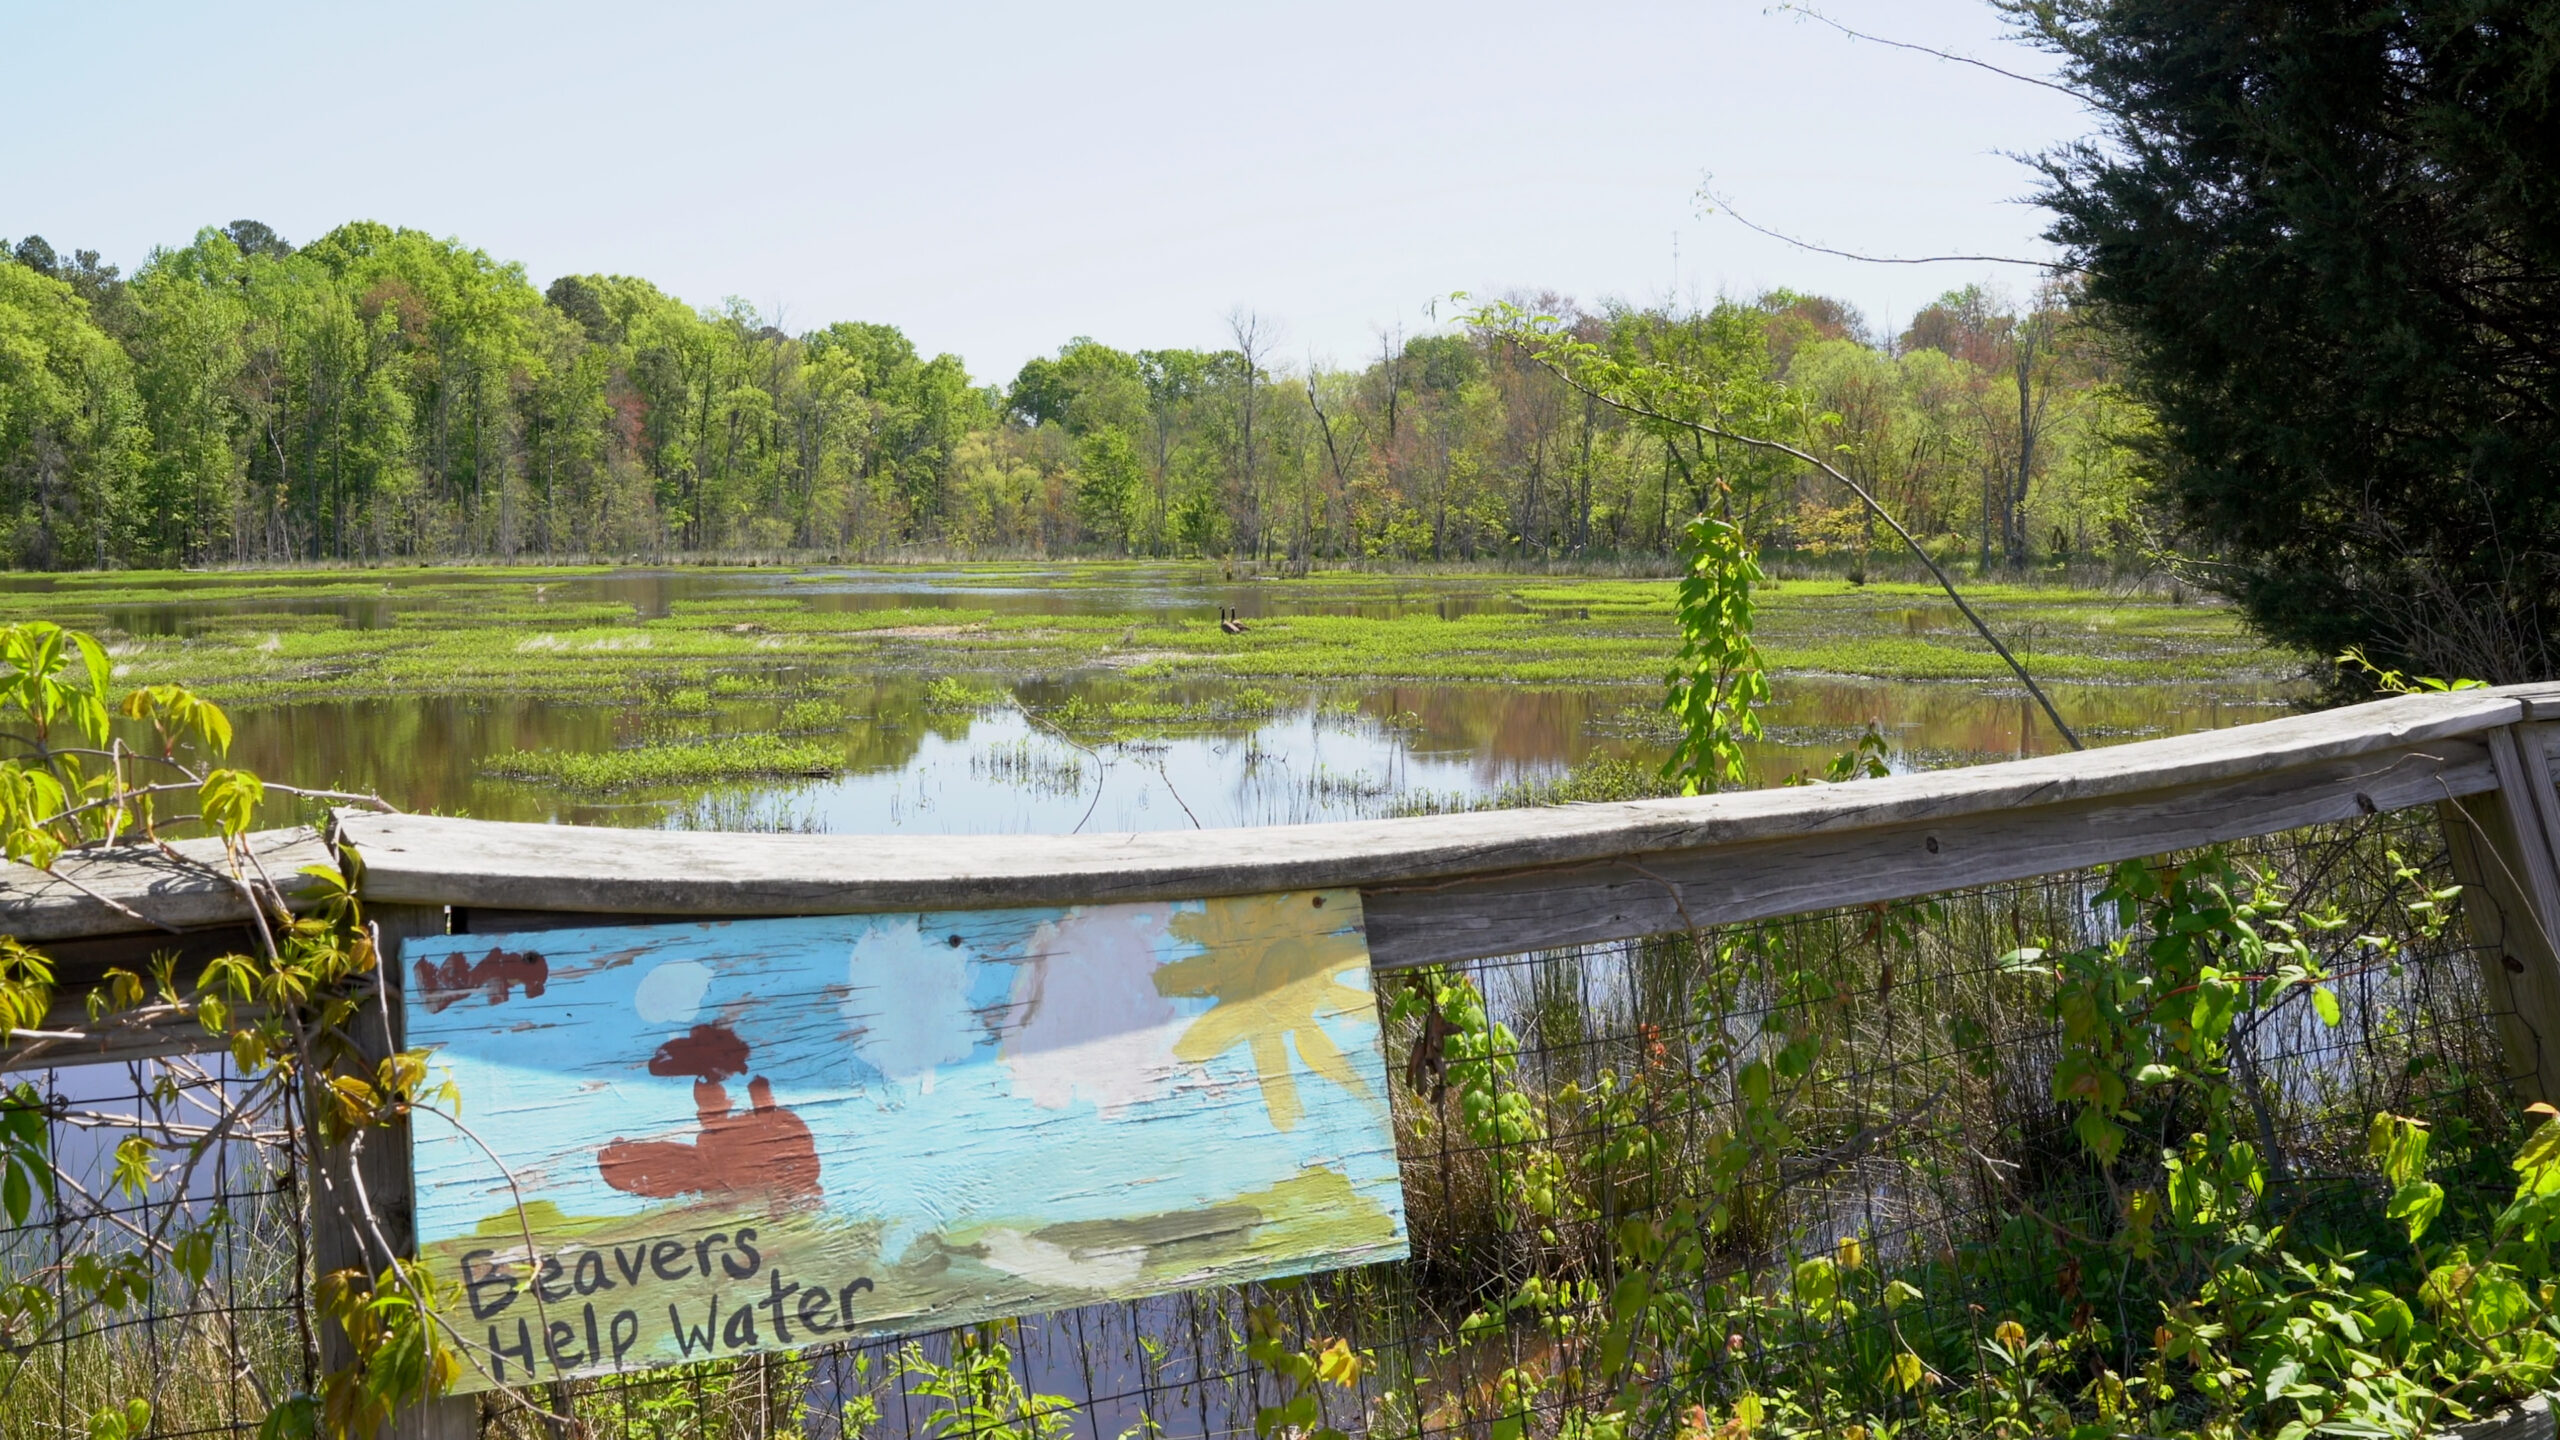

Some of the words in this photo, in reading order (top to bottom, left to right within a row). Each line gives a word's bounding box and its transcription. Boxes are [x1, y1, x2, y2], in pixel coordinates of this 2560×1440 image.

[460, 1228, 761, 1320] Beavers
[488, 1302, 638, 1382] Help
[669, 1268, 874, 1357] Water
